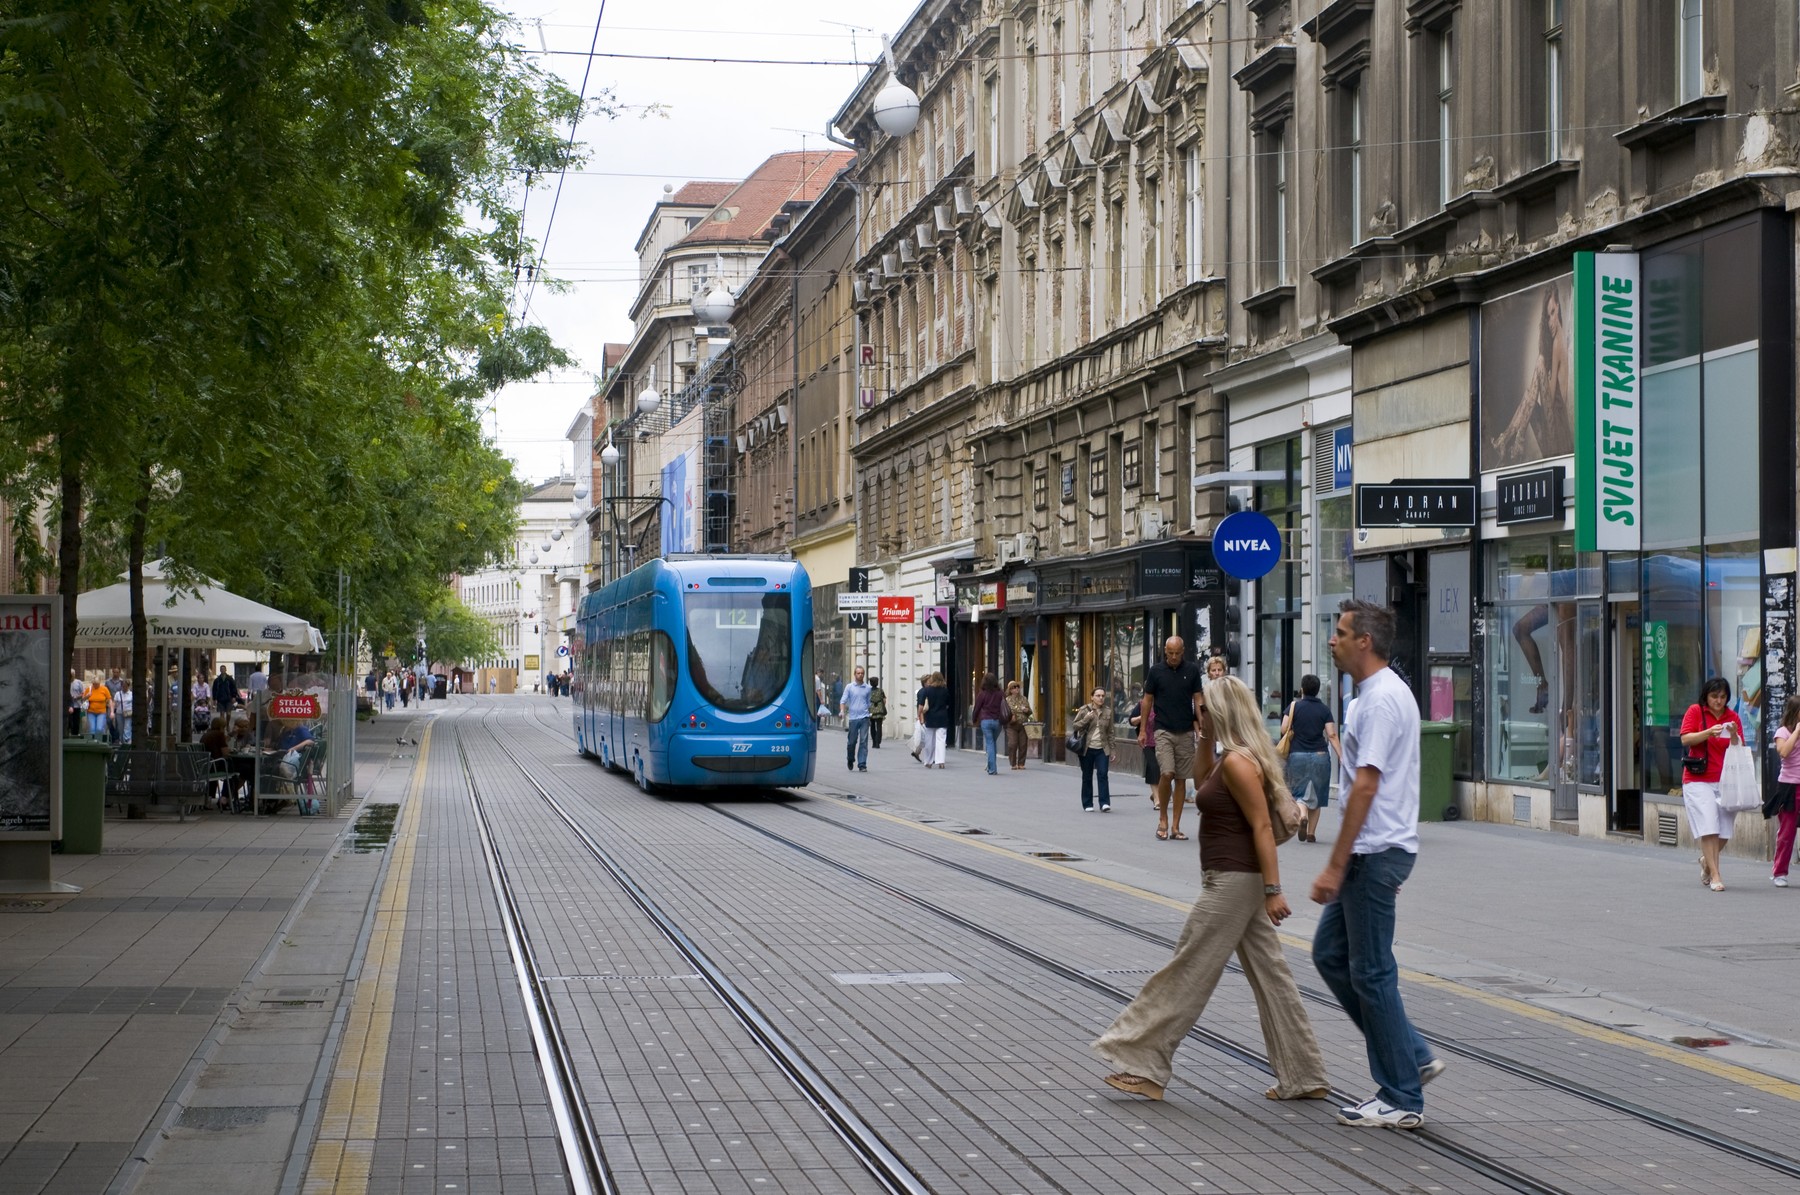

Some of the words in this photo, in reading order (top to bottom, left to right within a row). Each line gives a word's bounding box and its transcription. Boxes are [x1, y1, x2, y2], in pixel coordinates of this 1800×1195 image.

[1601, 275, 1636, 410] TKANINE
[862, 346, 873, 364] R
[862, 389, 873, 407] U
[1602, 420, 1634, 527] SVIJET
[1505, 480, 1546, 504] JADRAN
[1379, 495, 1457, 509] JADRAN
[1224, 539, 1271, 551] NIVEA
[1440, 588, 1459, 613] LEX
[0, 605, 50, 630] ndt
[729, 609, 747, 625] 12
[882, 607, 910, 617] Triumph
[153, 626, 173, 635] IMA
[177, 627, 208, 637] SVOJU
[211, 628, 249, 638] CIJENU.
[0, 816, 23, 826] agreb
